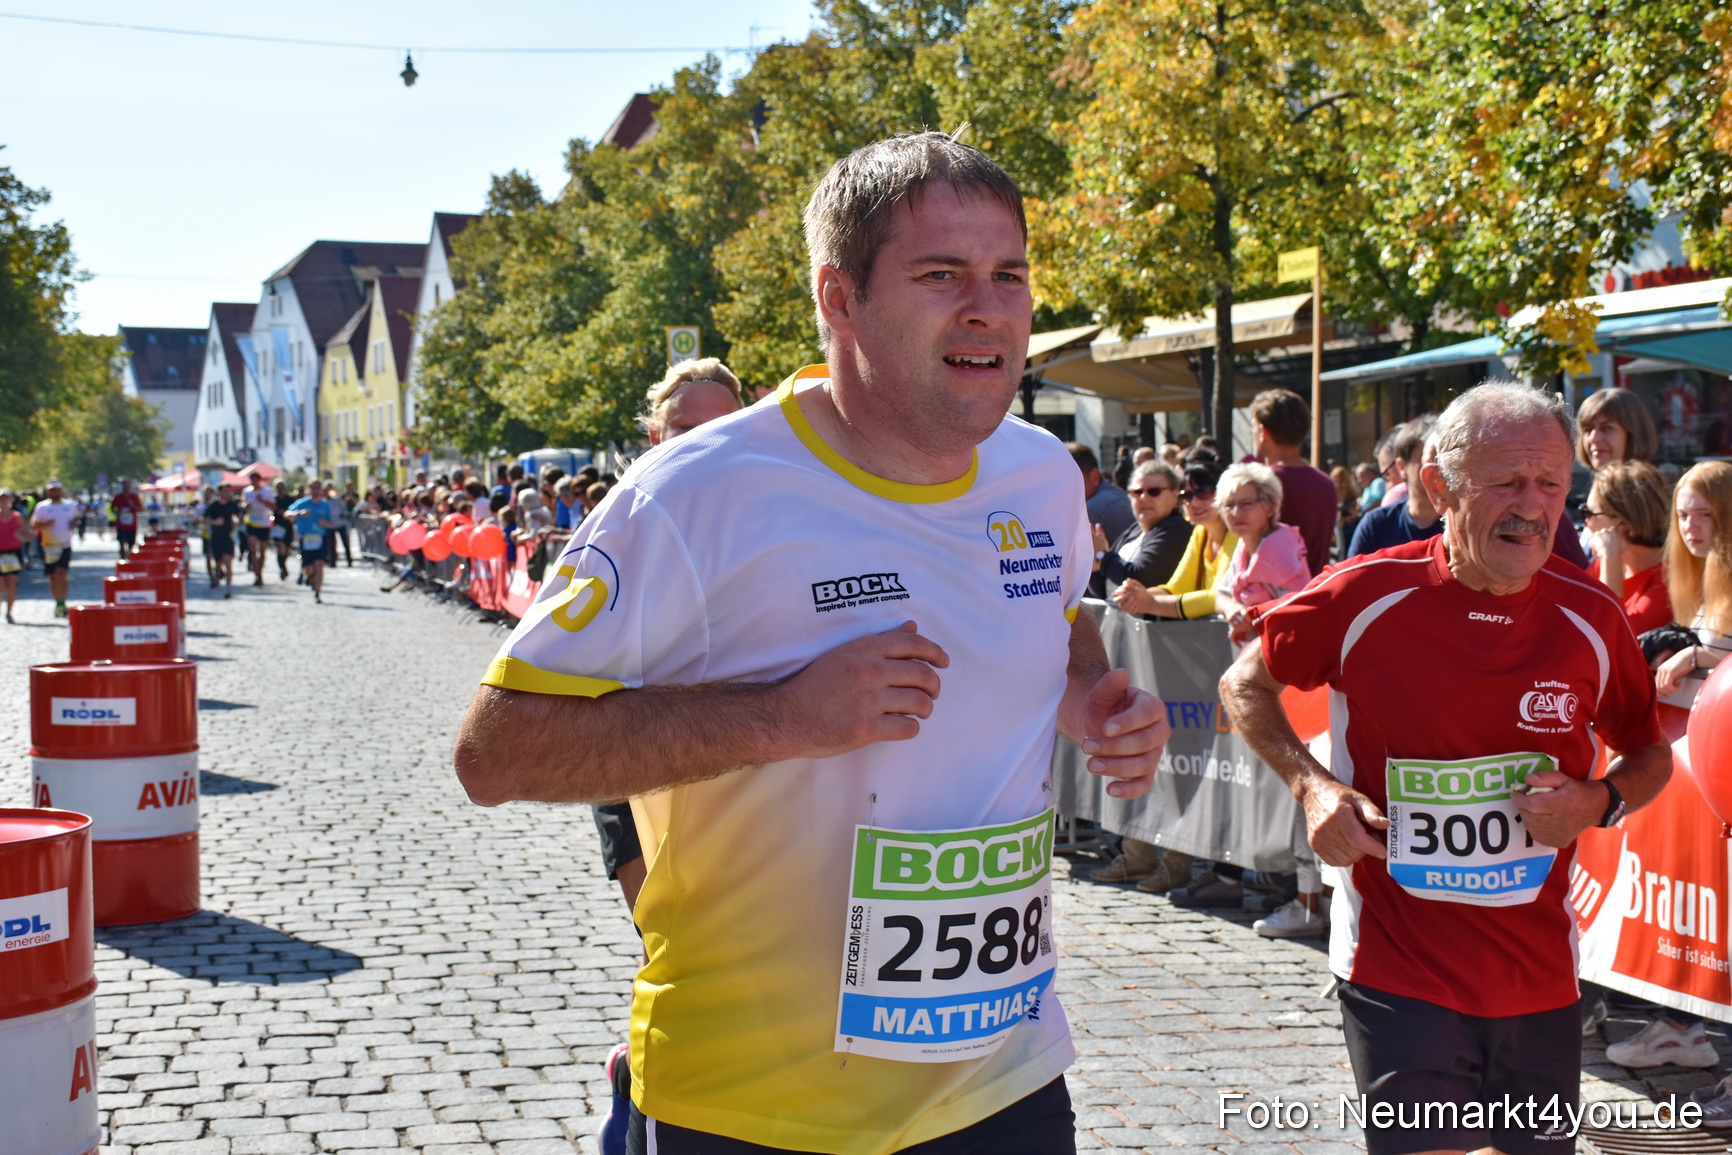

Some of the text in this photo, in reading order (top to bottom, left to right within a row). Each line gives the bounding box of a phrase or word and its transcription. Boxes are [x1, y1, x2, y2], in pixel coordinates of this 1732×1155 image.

[990, 519, 1051, 552] 20 JAHRE
[812, 573, 906, 605] BOCK
[816, 592, 910, 613] inspired by smart concepts
[1003, 575, 1062, 599] Stadtlauf
[1468, 611, 1505, 624] CRAFT
[1534, 680, 1570, 690] Laufteam
[1516, 721, 1550, 734] Kraftsport
[1401, 758, 1538, 799] BOCK
[873, 821, 1049, 892] BOCK
[1425, 865, 1528, 891] RUDOLF
[1622, 849, 1718, 945] Braun
[5, 932, 51, 949] energie
[877, 896, 1042, 982] 2588
[1657, 936, 1730, 974] Sicher ist sicher
[872, 985, 1039, 1036] MATTHIAS
